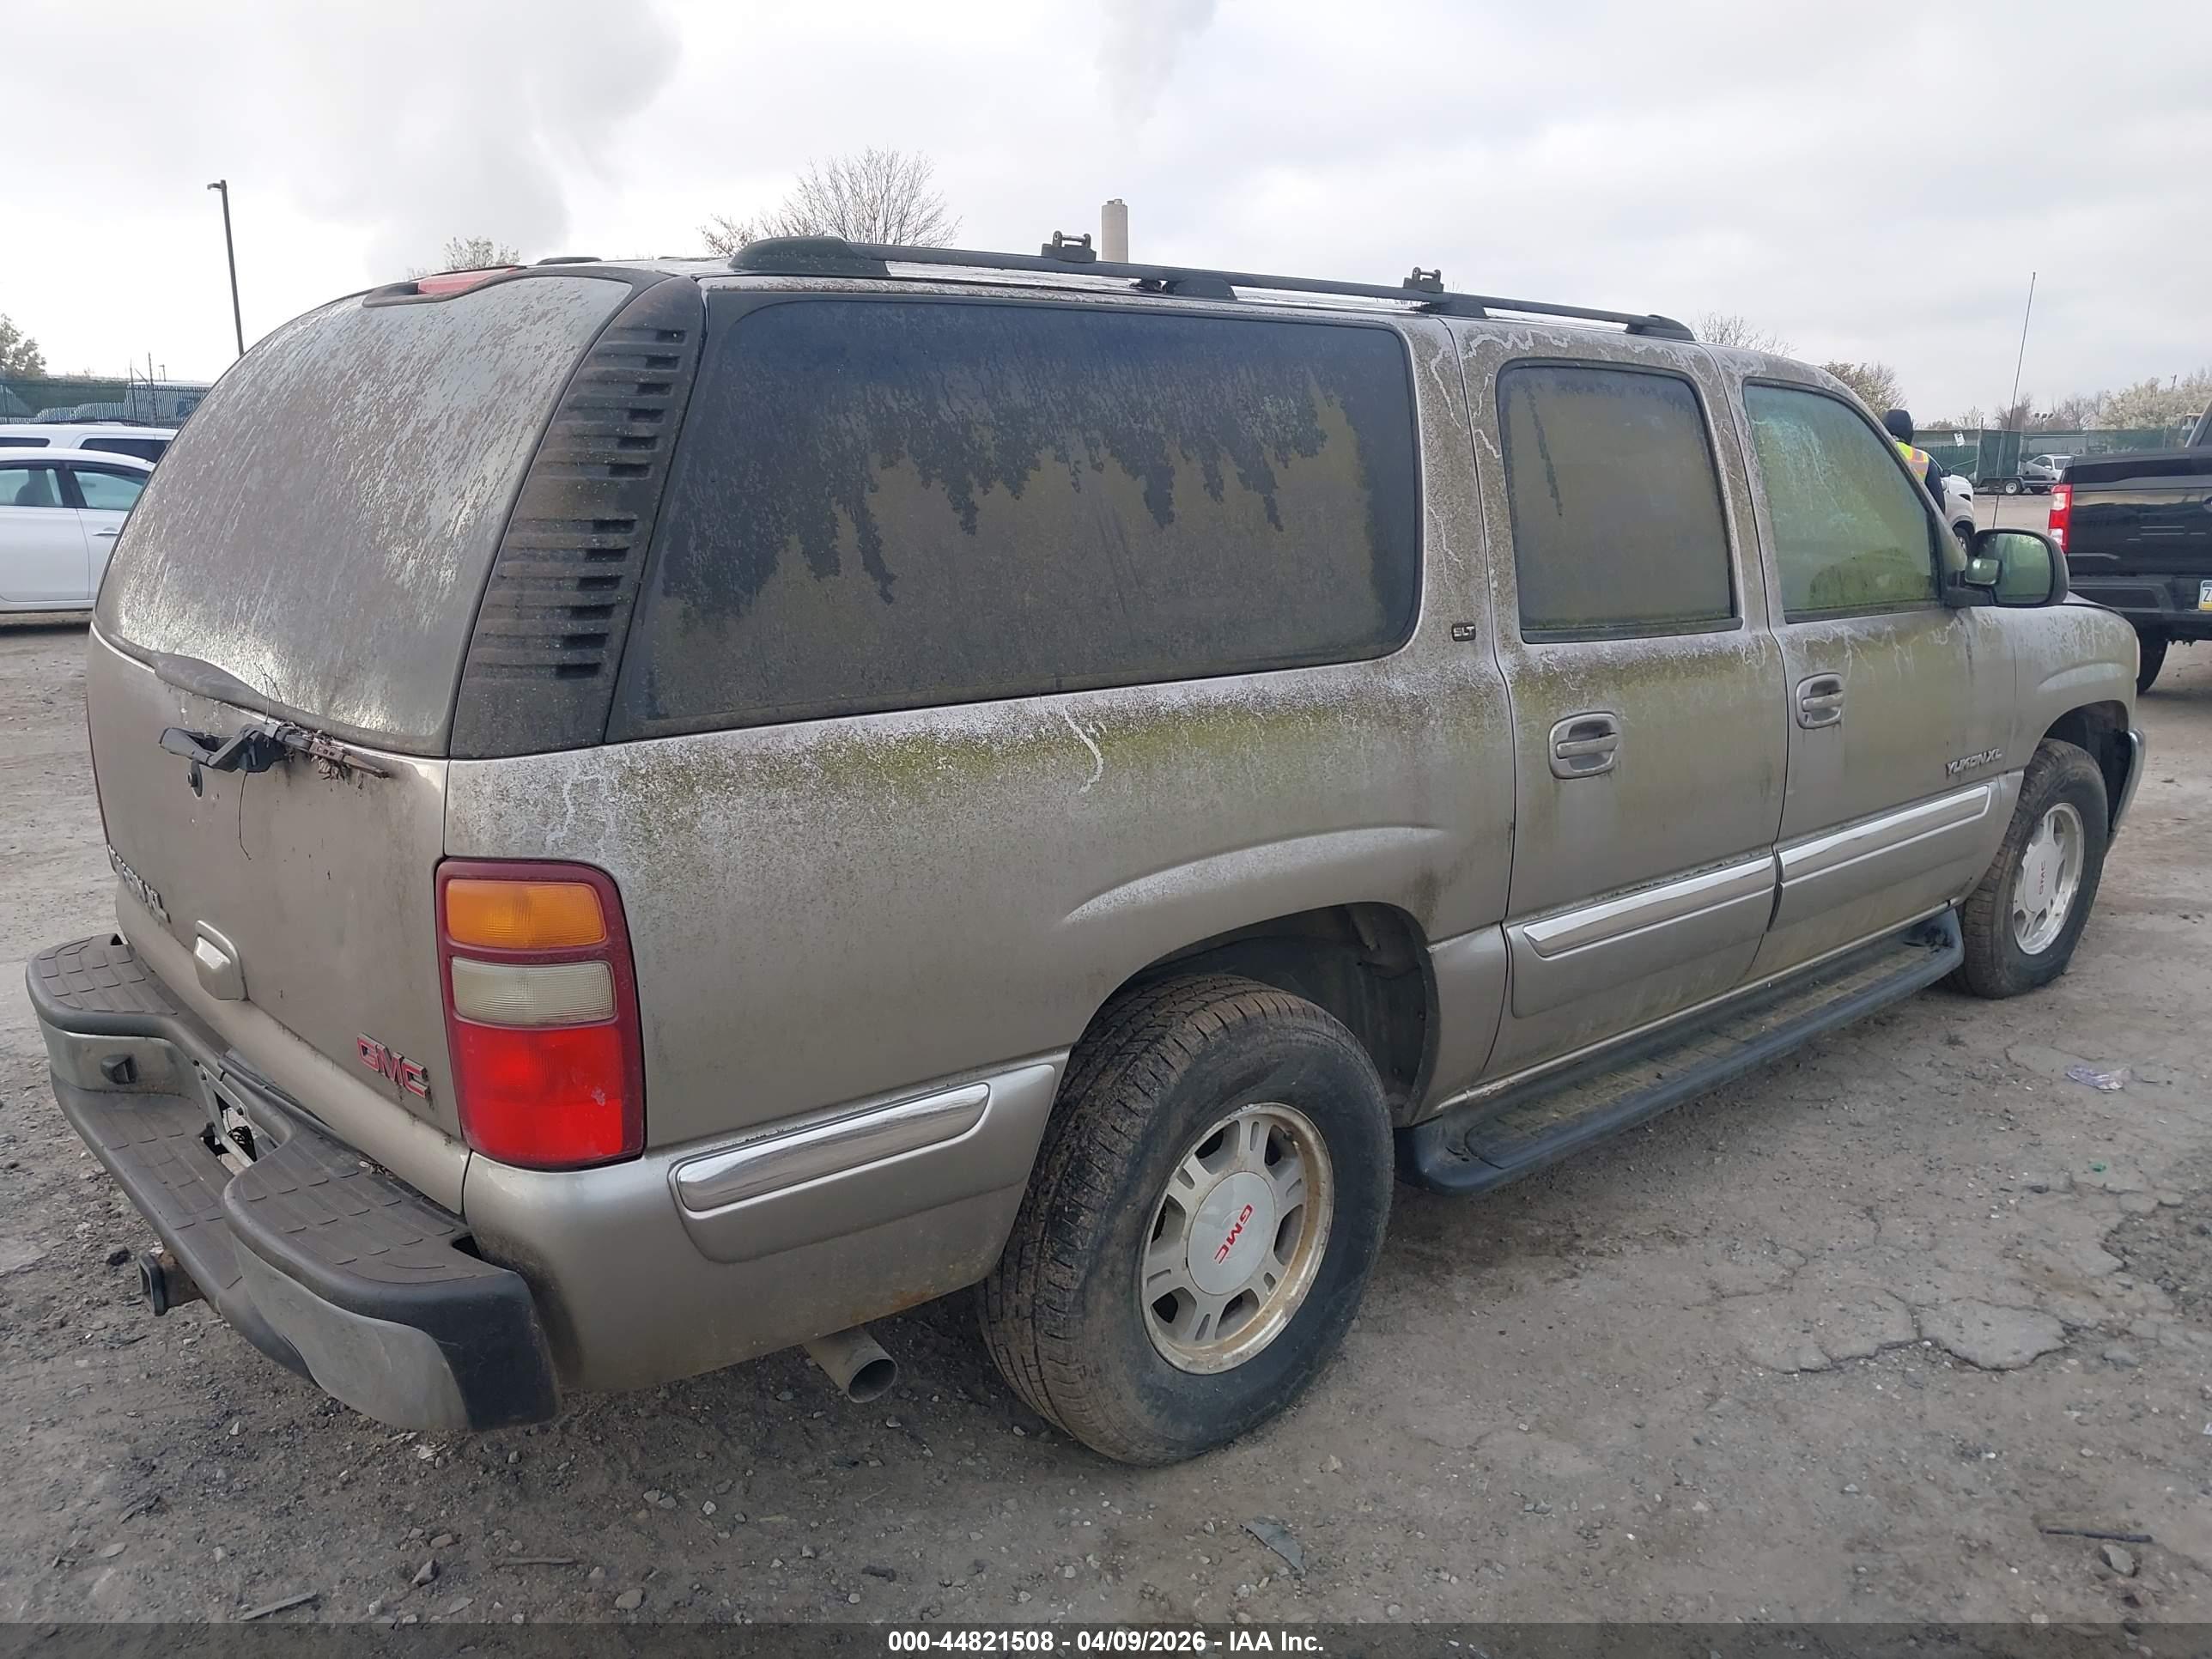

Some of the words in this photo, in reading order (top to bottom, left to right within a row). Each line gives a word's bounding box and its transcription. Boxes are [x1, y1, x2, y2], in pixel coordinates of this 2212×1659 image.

[1453, 625, 1475, 637] SLT
[356, 1032, 429, 1098] GMC
[1213, 1204, 1254, 1265] GMC
